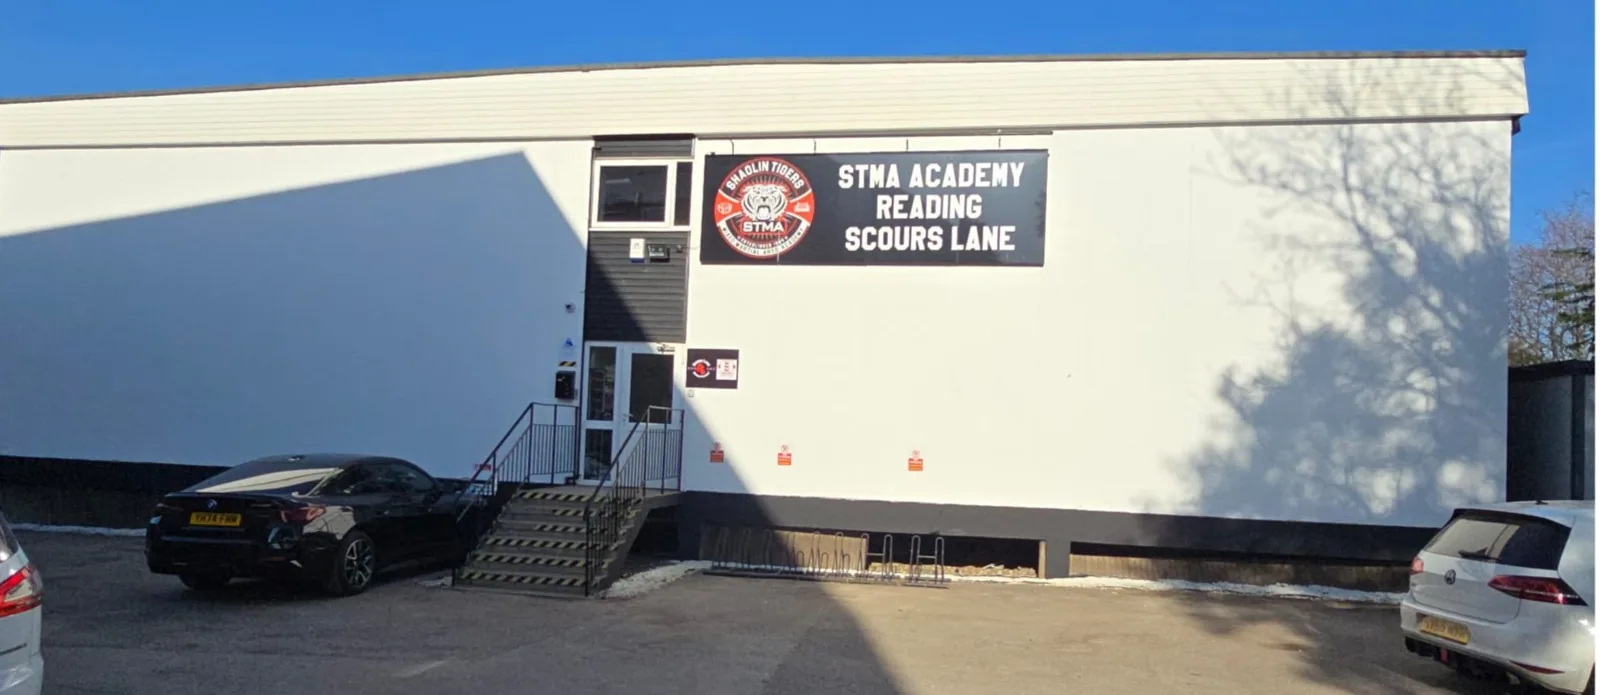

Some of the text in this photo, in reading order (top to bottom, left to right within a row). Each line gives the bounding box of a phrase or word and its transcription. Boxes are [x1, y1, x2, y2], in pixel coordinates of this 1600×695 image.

[726, 160, 805, 190] SHAOLIN TIGERS
[838, 161, 1025, 189] STMA ACADEMY
[876, 194, 983, 219] READING
[743, 221, 784, 232] STMA
[845, 225, 1016, 251] SCOURS LANE
